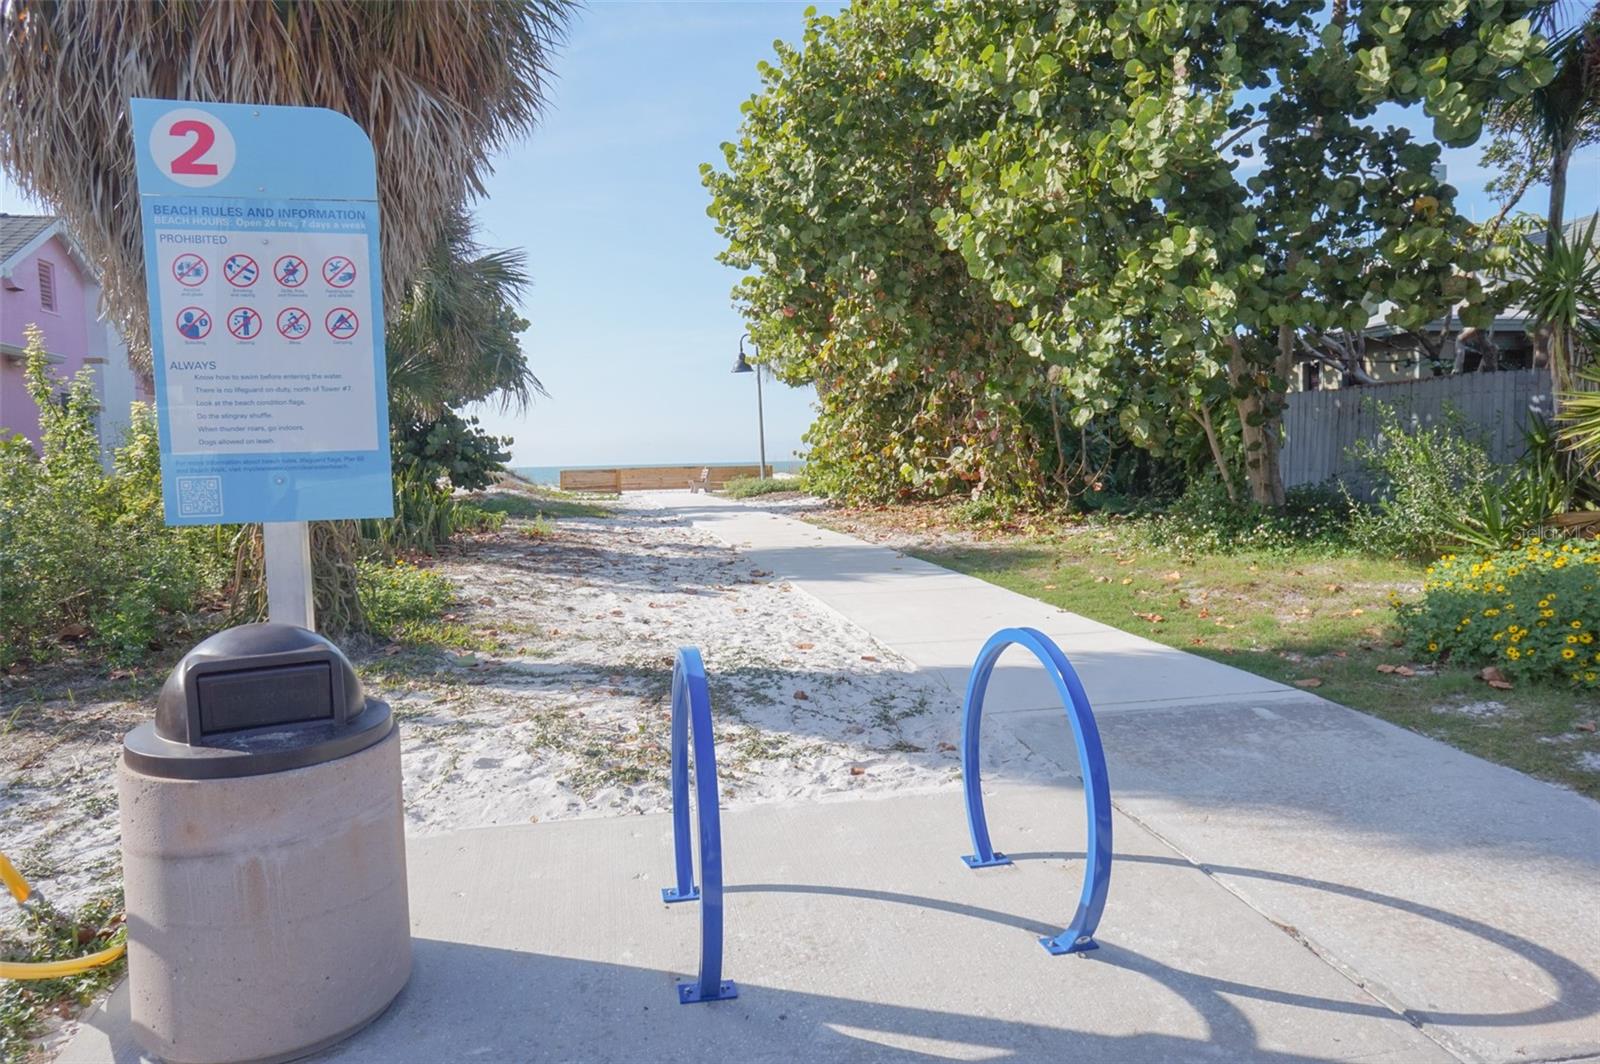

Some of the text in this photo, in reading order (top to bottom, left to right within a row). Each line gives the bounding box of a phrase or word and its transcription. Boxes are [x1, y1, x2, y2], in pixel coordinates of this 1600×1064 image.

[169, 120, 218, 176] 2
[153, 204, 367, 220] BEACH RULES AND INFORMATION
[154, 215, 190, 225] BEACH
[236, 217, 262, 228] Open
[264, 219, 276, 228] 24
[308, 220, 332, 230] days
[341, 221, 367, 230] week
[160, 233, 228, 245] PROHIBITED
[169, 361, 217, 371] ALWAYS
[234, 386, 264, 394] lifeguard
